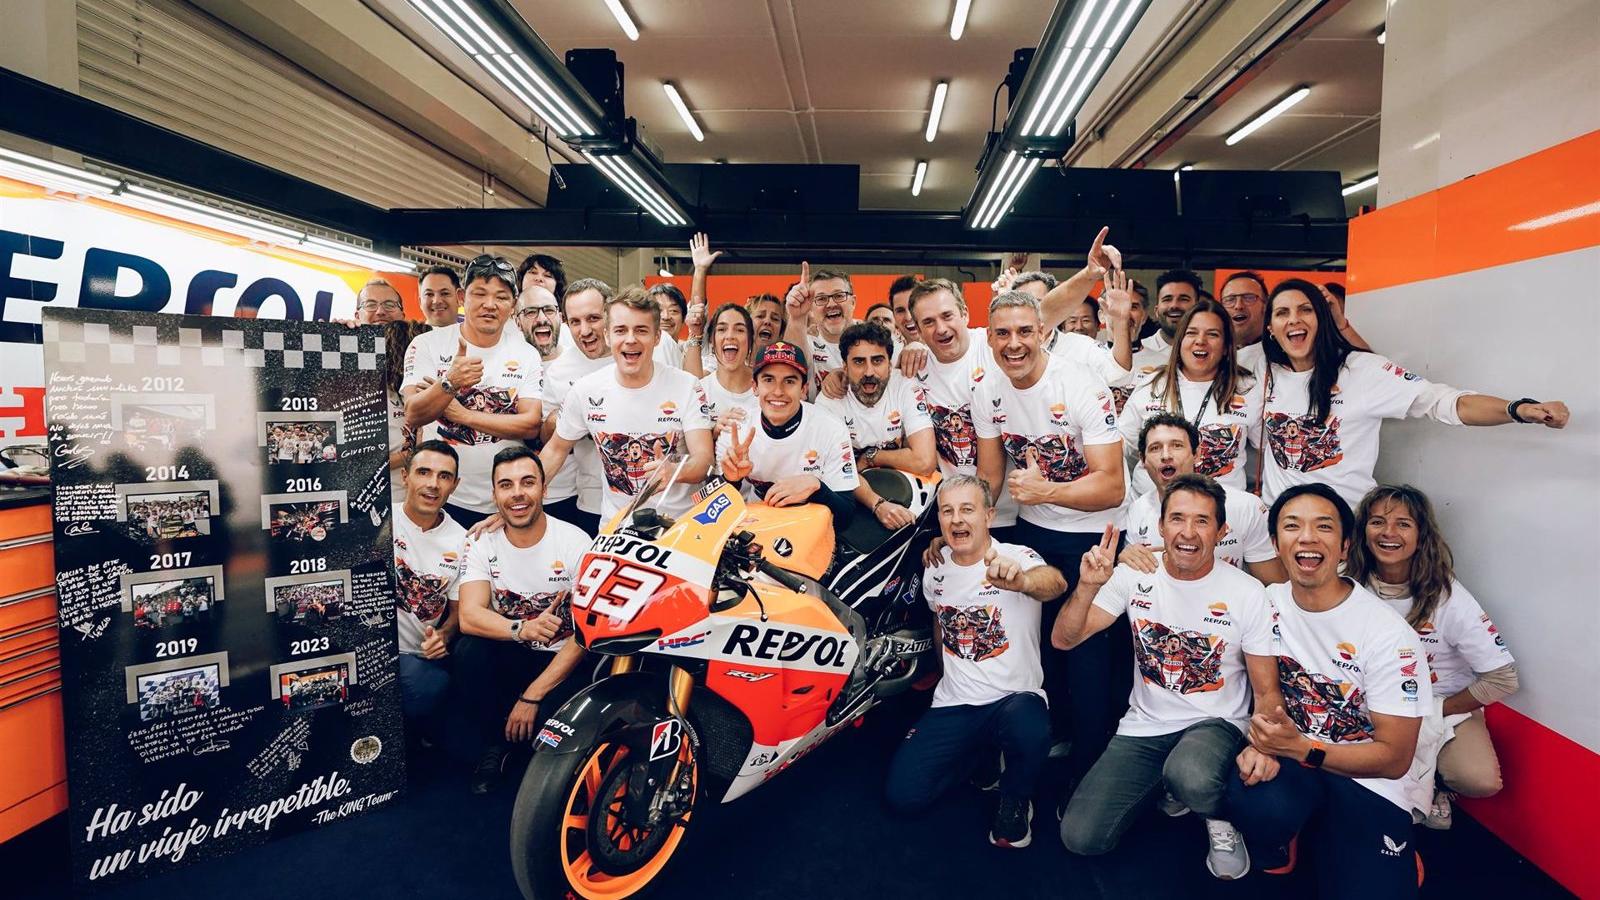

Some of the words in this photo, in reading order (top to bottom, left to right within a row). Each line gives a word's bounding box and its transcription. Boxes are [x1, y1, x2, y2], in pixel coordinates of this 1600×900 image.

[141, 377, 186, 392] 2012
[281, 397, 319, 412] 2013
[587, 413, 607, 422] HRC
[145, 465, 190, 482] 2014
[286, 478, 323, 493] 2016
[706, 476, 723, 492] 93
[707, 494, 730, 520] GAS
[149, 551, 193, 570] 2017
[590, 532, 674, 571] REPSOL
[289, 556, 328, 575] 2018
[438, 562, 458, 571] REPSOL
[572, 555, 668, 626] 93
[1130, 598, 1152, 610] HRC
[1202, 615, 1233, 628] REPSOL
[156, 638, 198, 657] 2019
[290, 637, 331, 655] 2023
[658, 631, 705, 651] HRC
[721, 623, 851, 668] REPSOL
[86, 803, 137, 842] Ha
[137, 781, 204, 826] sido
[338, 800, 365, 817] KING
[89, 848, 138, 881] un
[137, 816, 211, 864] viaje
[213, 770, 353, 839] irrepetible.
